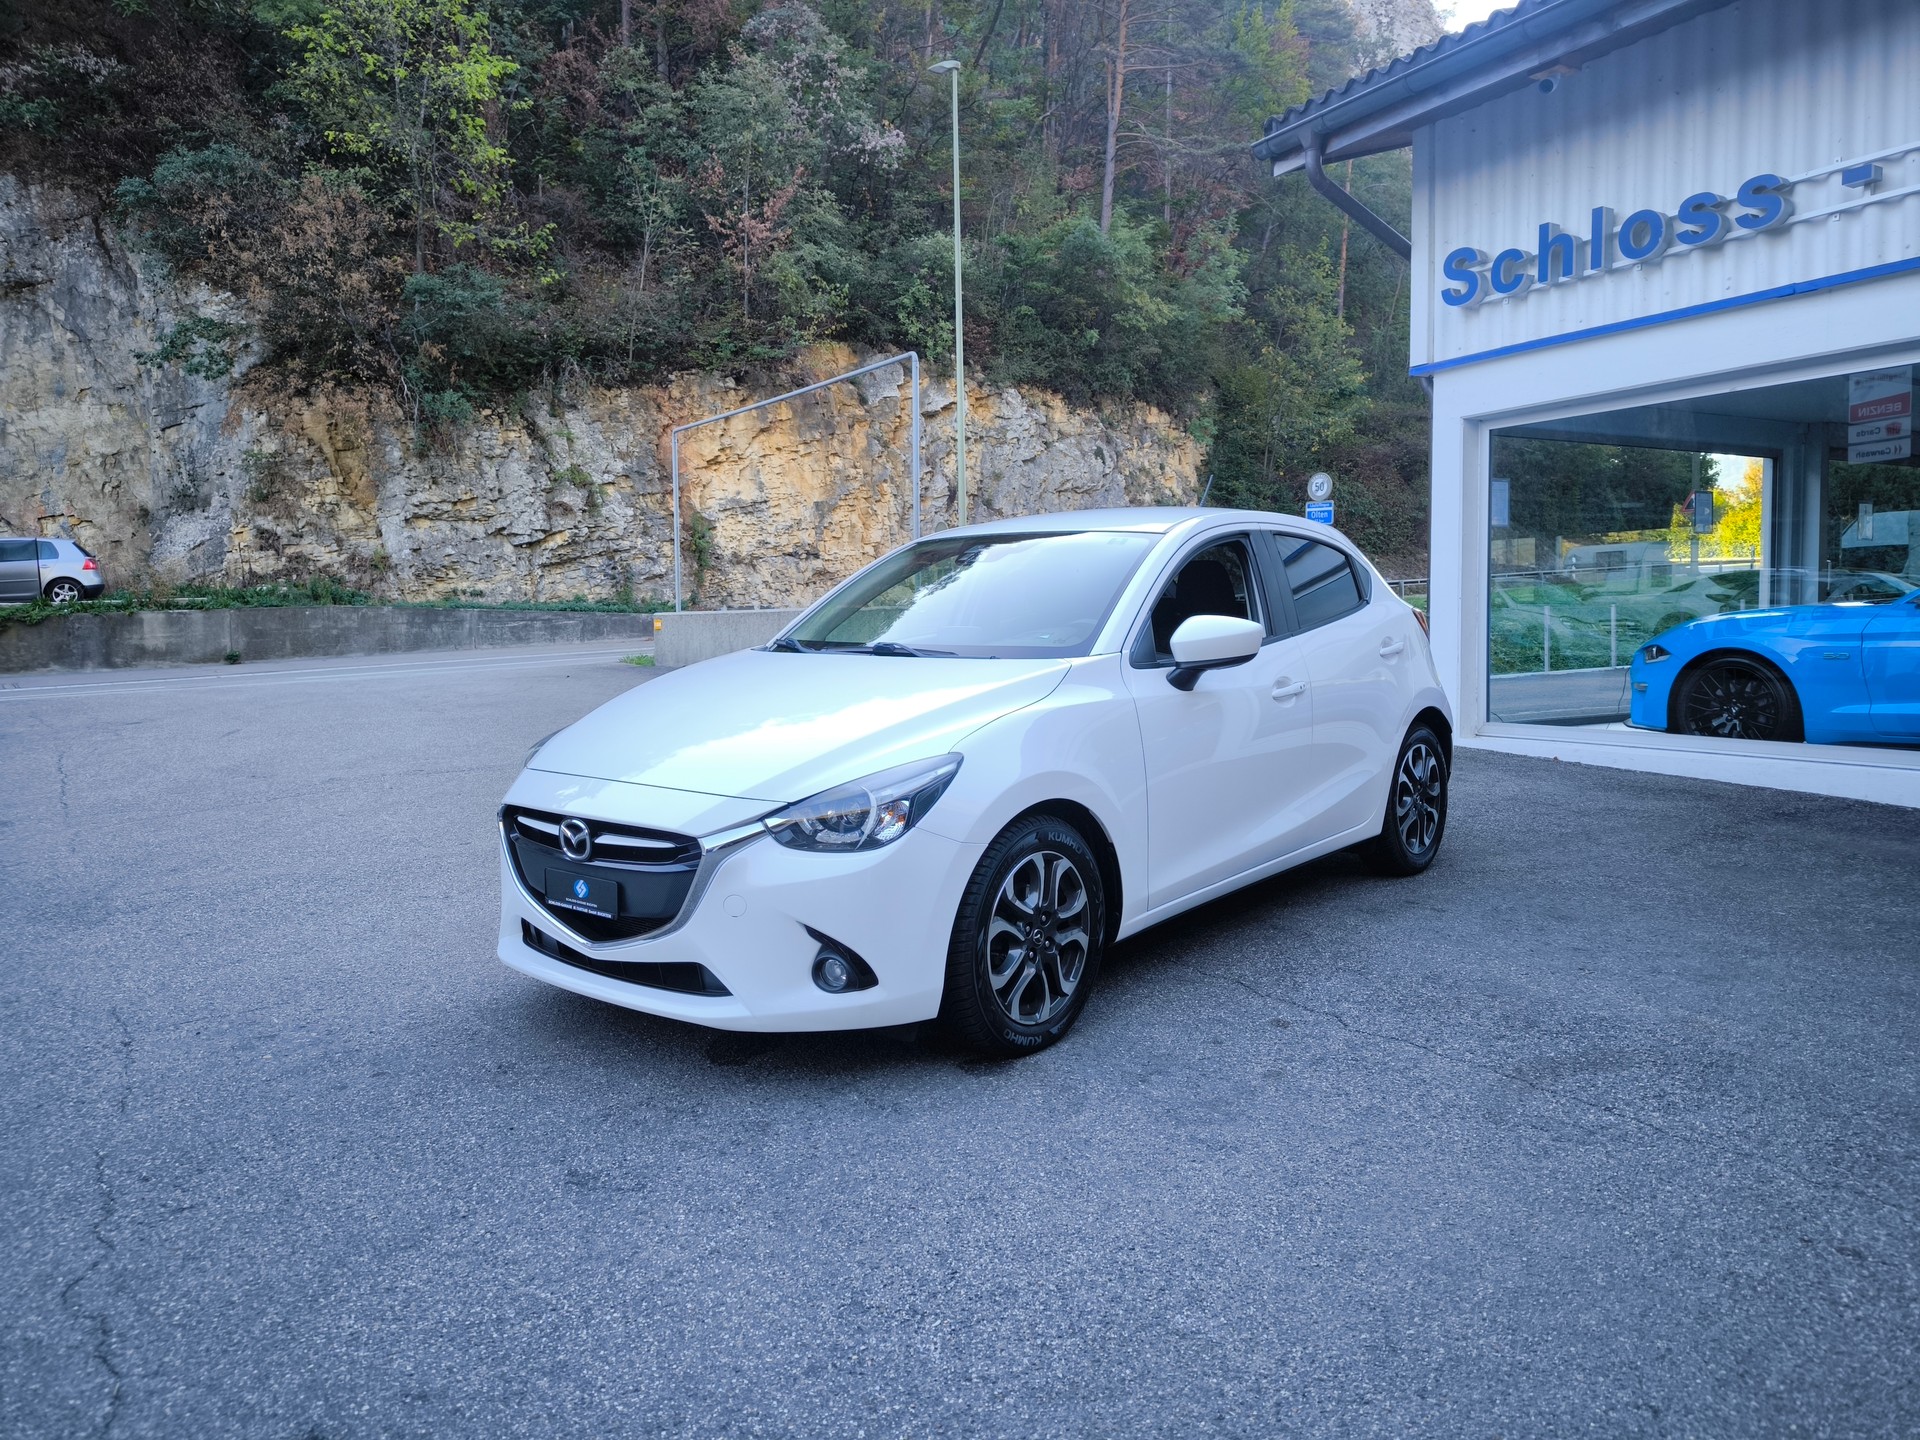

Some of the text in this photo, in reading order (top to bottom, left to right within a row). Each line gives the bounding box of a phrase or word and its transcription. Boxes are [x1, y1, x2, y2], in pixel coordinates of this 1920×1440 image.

[1441, 172, 1790, 308] Schloss
[1315, 482, 1324, 491] 50
[1310, 511, 1328, 519] Olten
[1048, 831, 1082, 854] KUMHO
[1003, 1029, 1042, 1046] KUMHO
